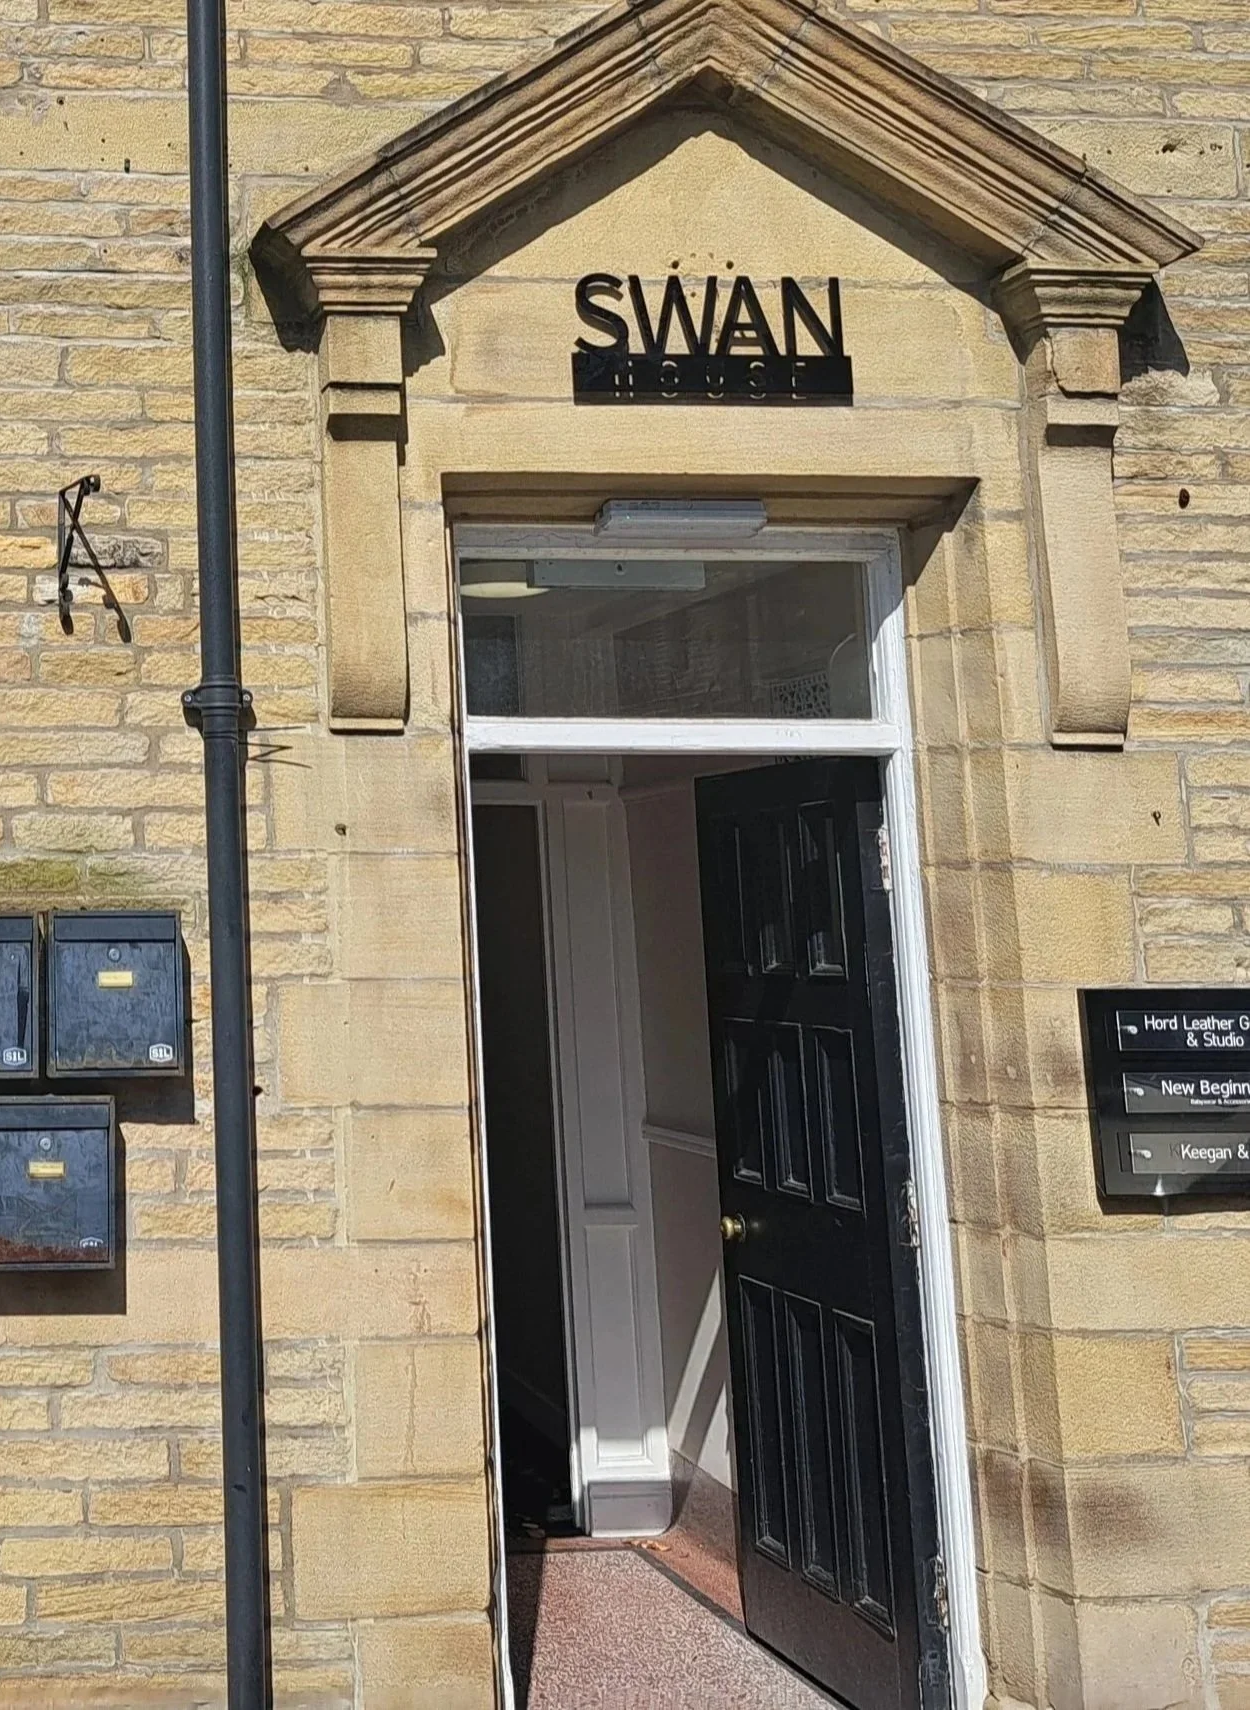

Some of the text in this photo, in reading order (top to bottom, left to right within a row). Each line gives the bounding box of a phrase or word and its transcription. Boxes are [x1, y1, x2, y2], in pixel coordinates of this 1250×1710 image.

[574, 272, 845, 357] SWAN
[1144, 1014, 1178, 1031] Hord
[1183, 1014, 1235, 1031] Leather
[1187, 1031, 1245, 1047] & Studio
[1161, 1079, 1195, 1096] New
[1181, 1143, 1250, 1163] Keegan &
